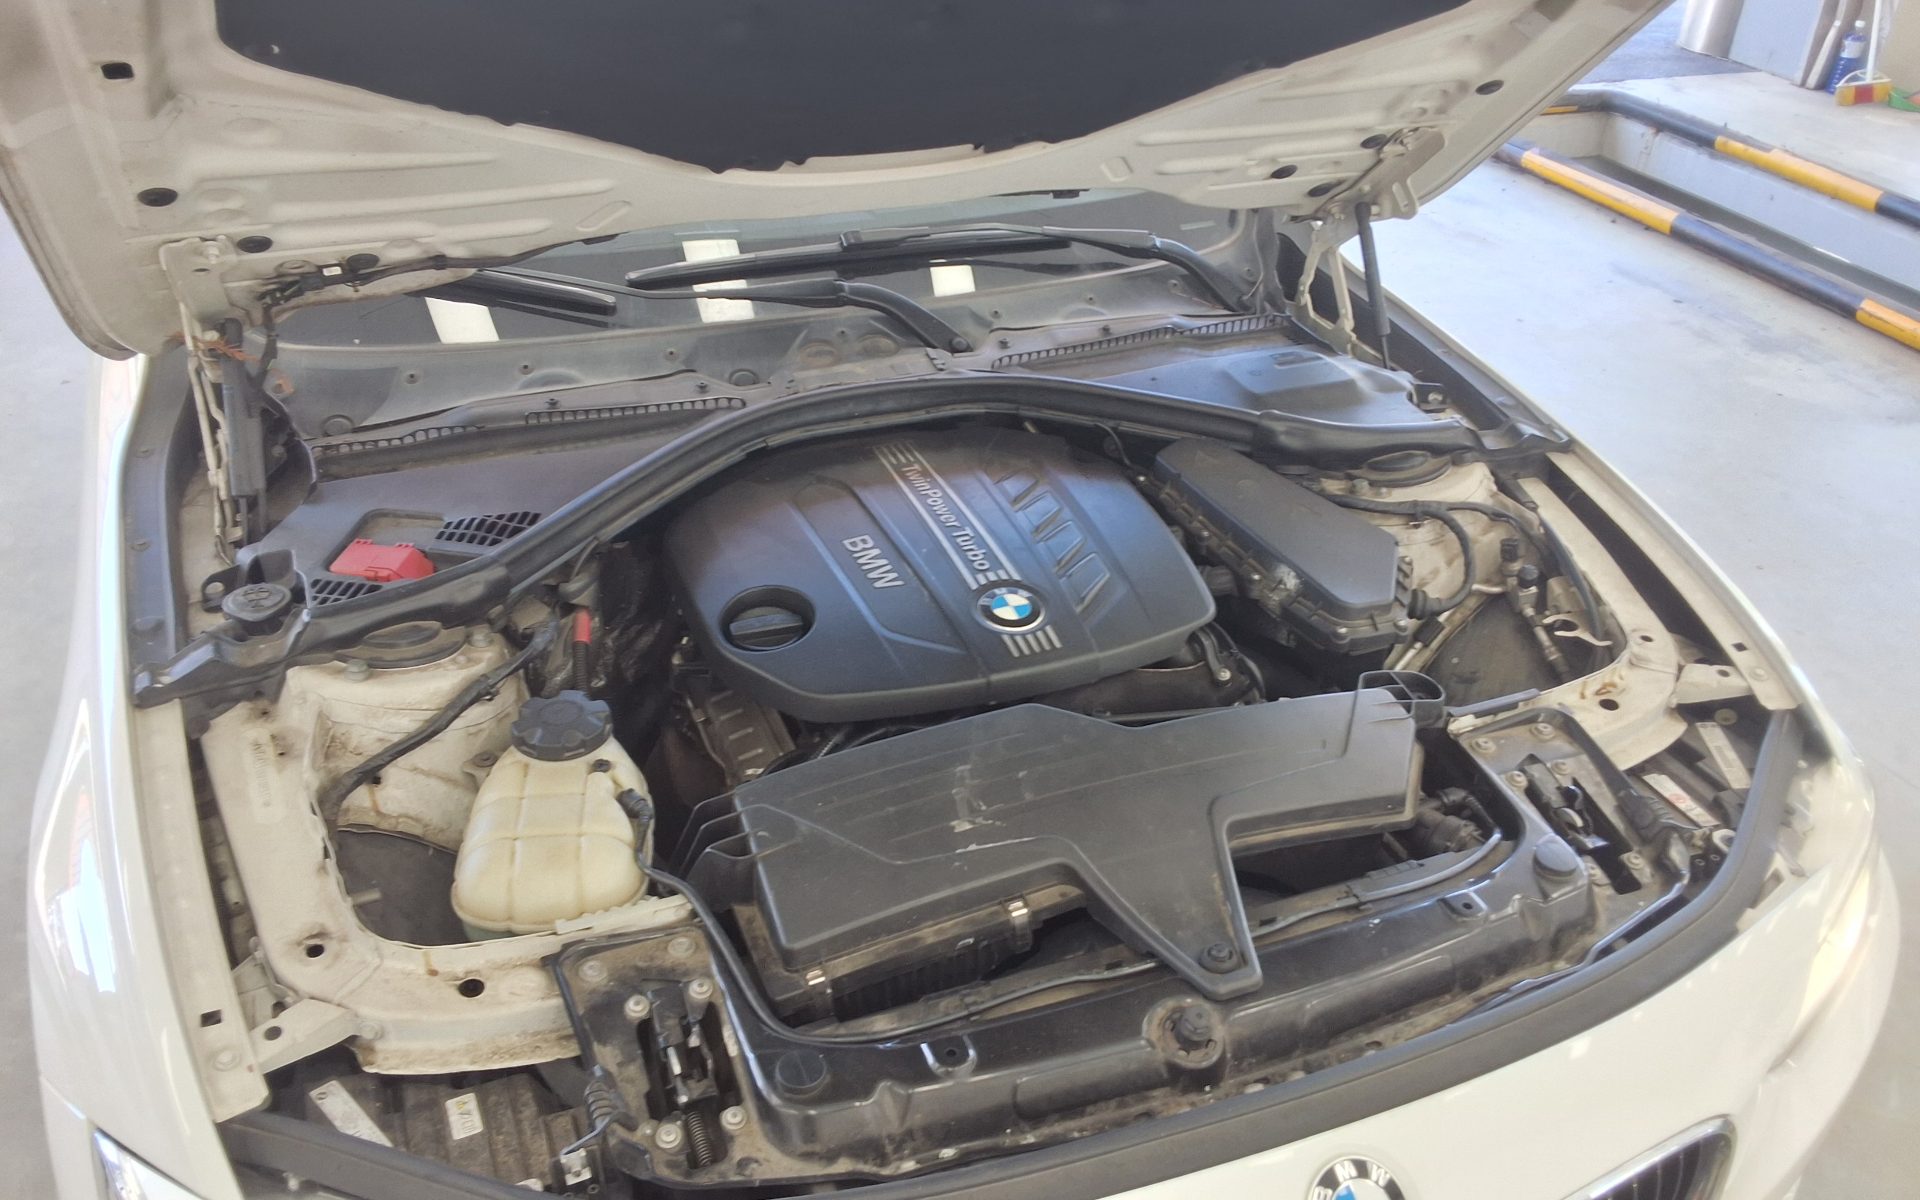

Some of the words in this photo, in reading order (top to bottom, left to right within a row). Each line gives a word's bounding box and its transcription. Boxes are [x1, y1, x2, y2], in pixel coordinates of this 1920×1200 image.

[903, 463, 959, 527] TwinPower
[952, 525, 990, 571] Turbo
[842, 534, 905, 589] BMW
